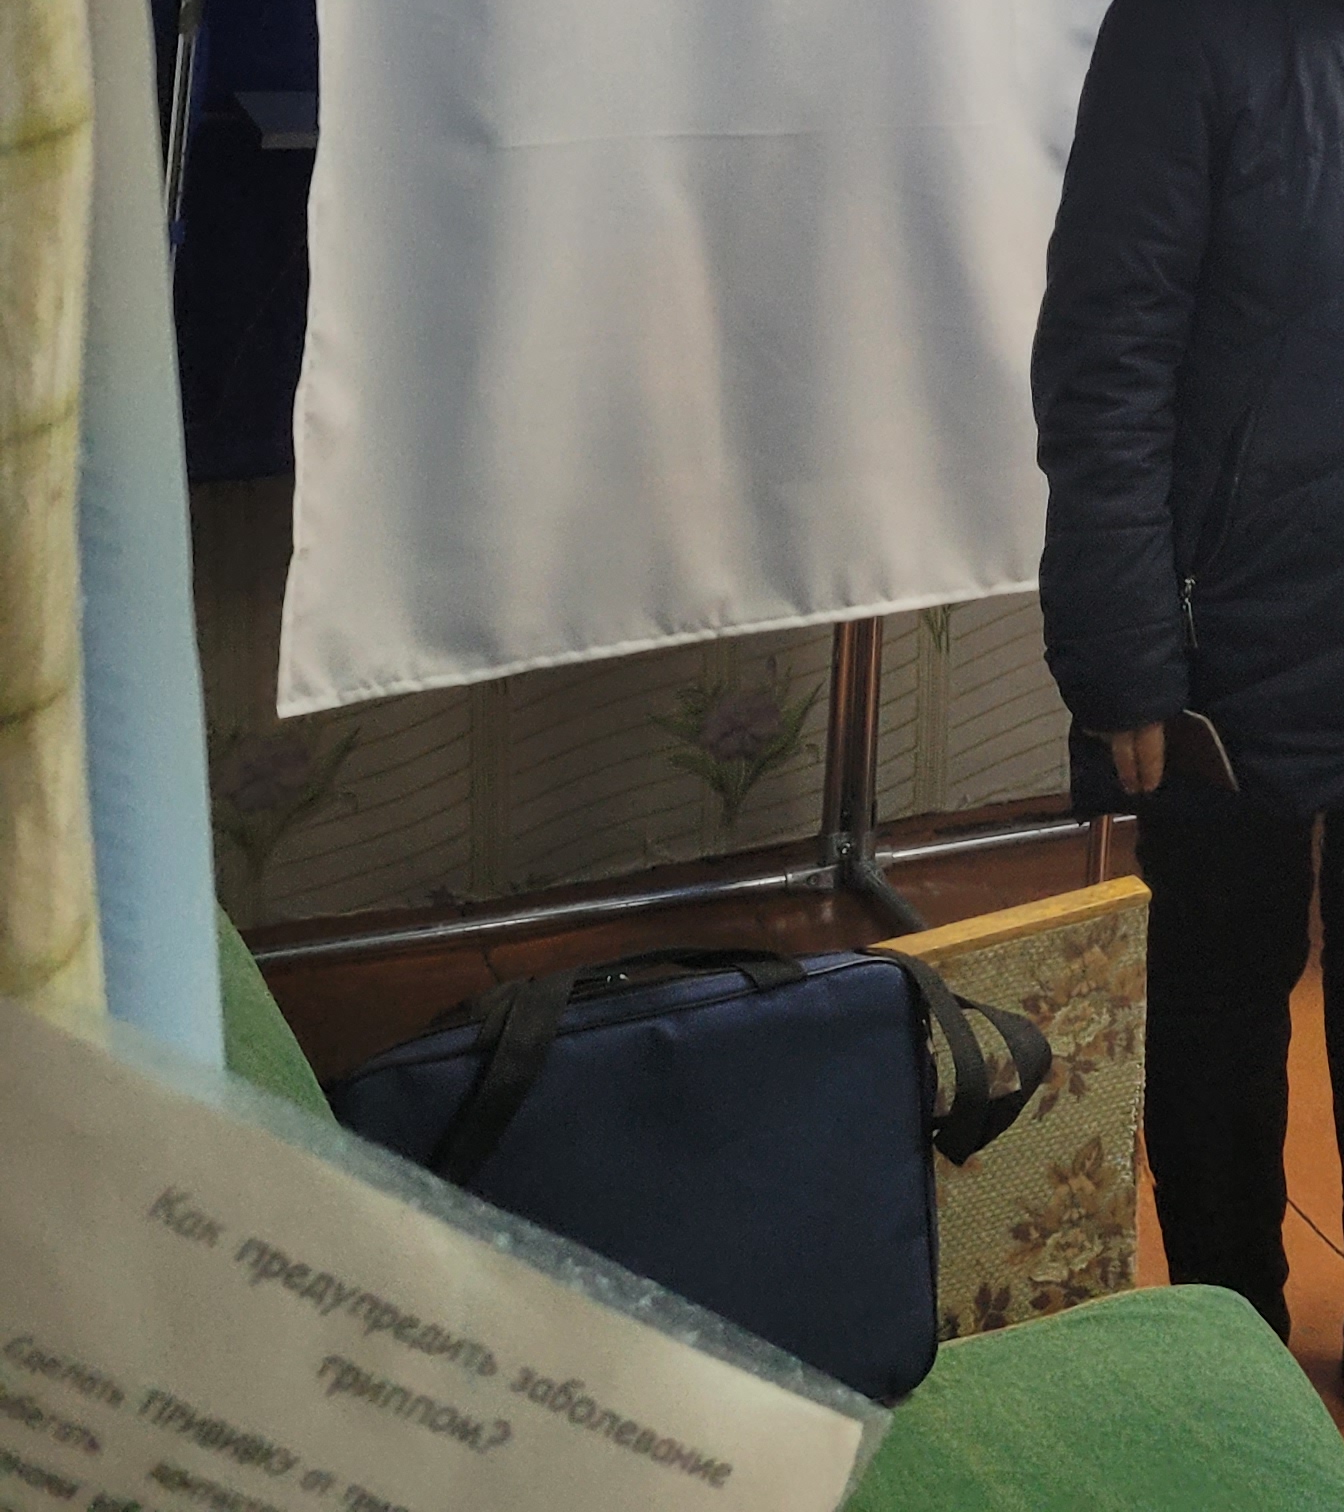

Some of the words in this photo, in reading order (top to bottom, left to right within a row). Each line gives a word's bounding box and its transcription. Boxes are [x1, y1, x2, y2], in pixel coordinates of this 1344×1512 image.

[149, 1185, 222, 1252] Как
[234, 1234, 500, 1379] предупредить
[509, 1364, 735, 1488] заболевание
[315, 1350, 515, 1454] гриппом?
